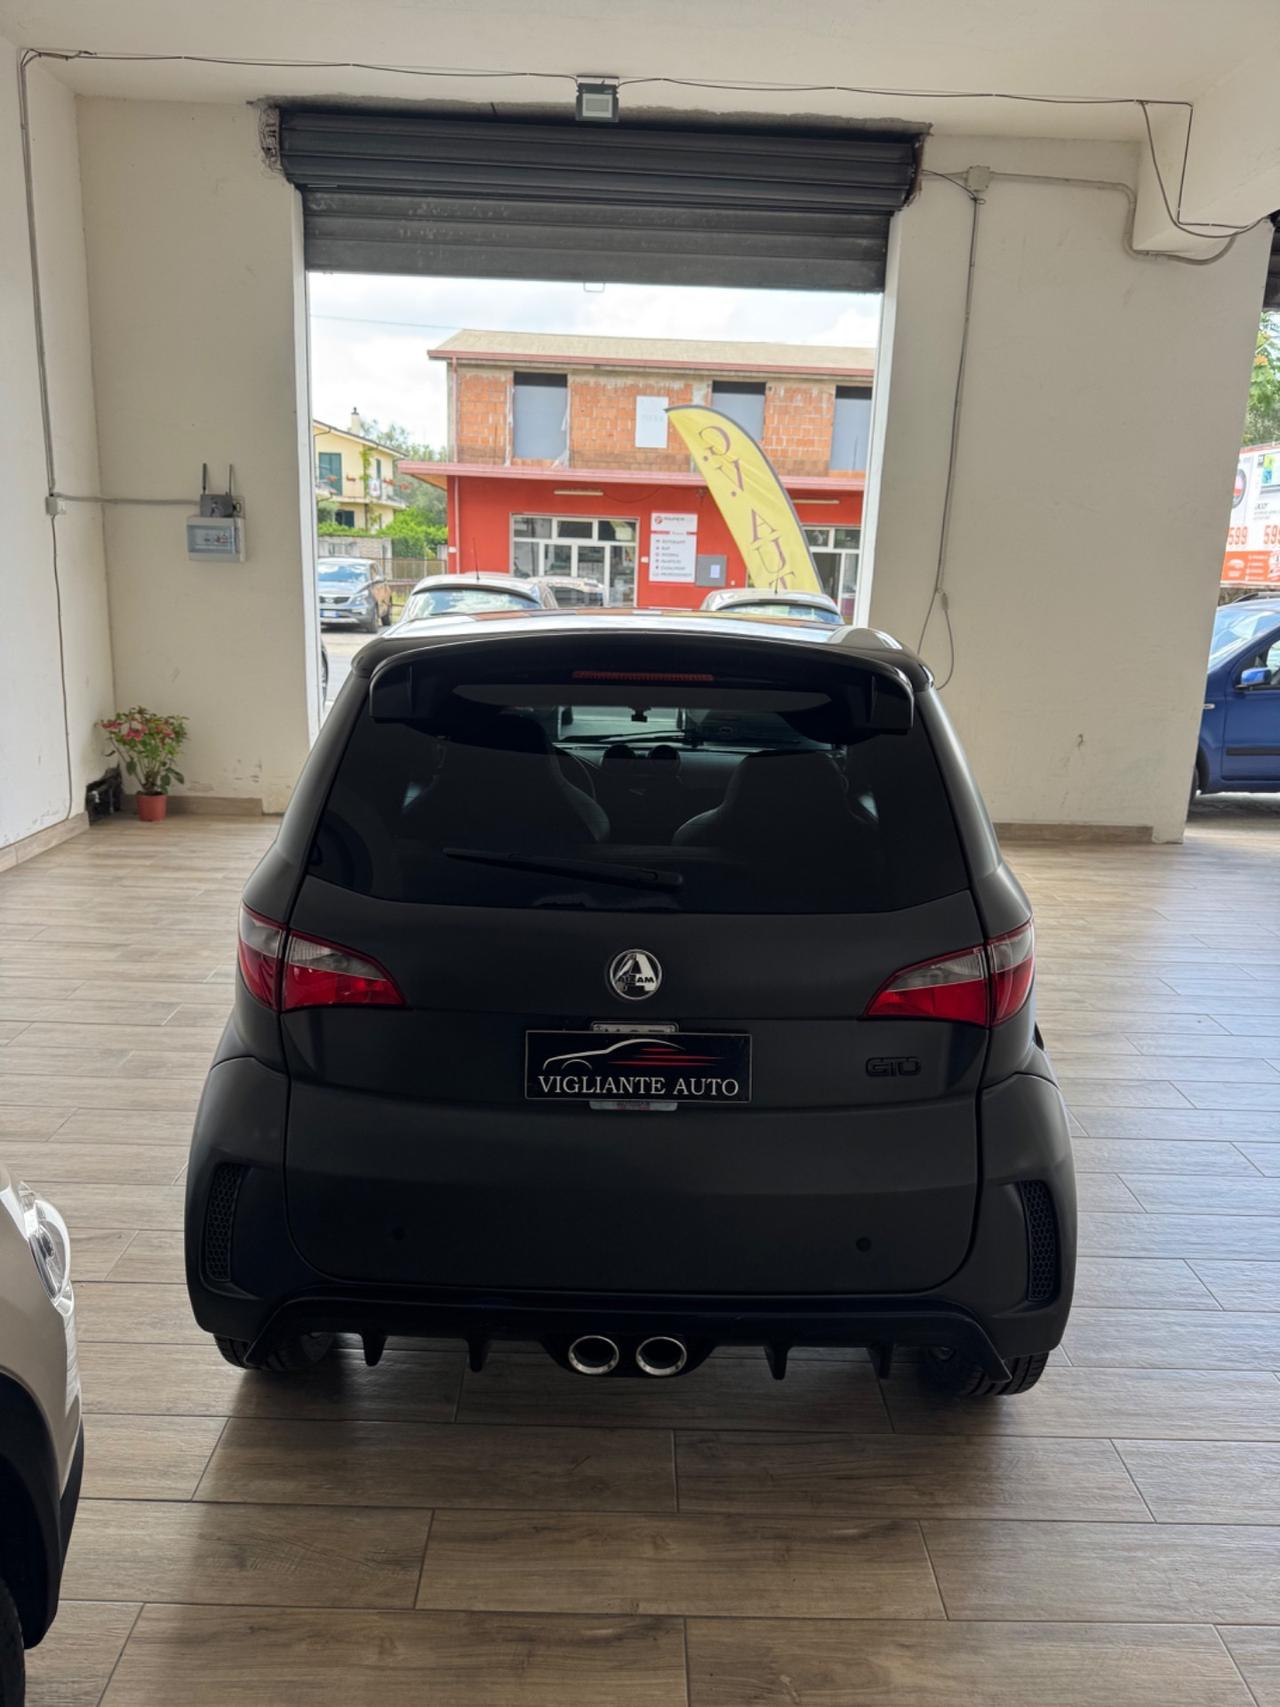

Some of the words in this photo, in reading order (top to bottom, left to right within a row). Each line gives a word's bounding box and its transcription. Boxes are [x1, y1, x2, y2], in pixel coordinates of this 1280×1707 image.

[865, 1056, 921, 1077] GTO
[538, 1075, 666, 1095] VIGLIANTE
[673, 1078, 739, 1096] AUTO
